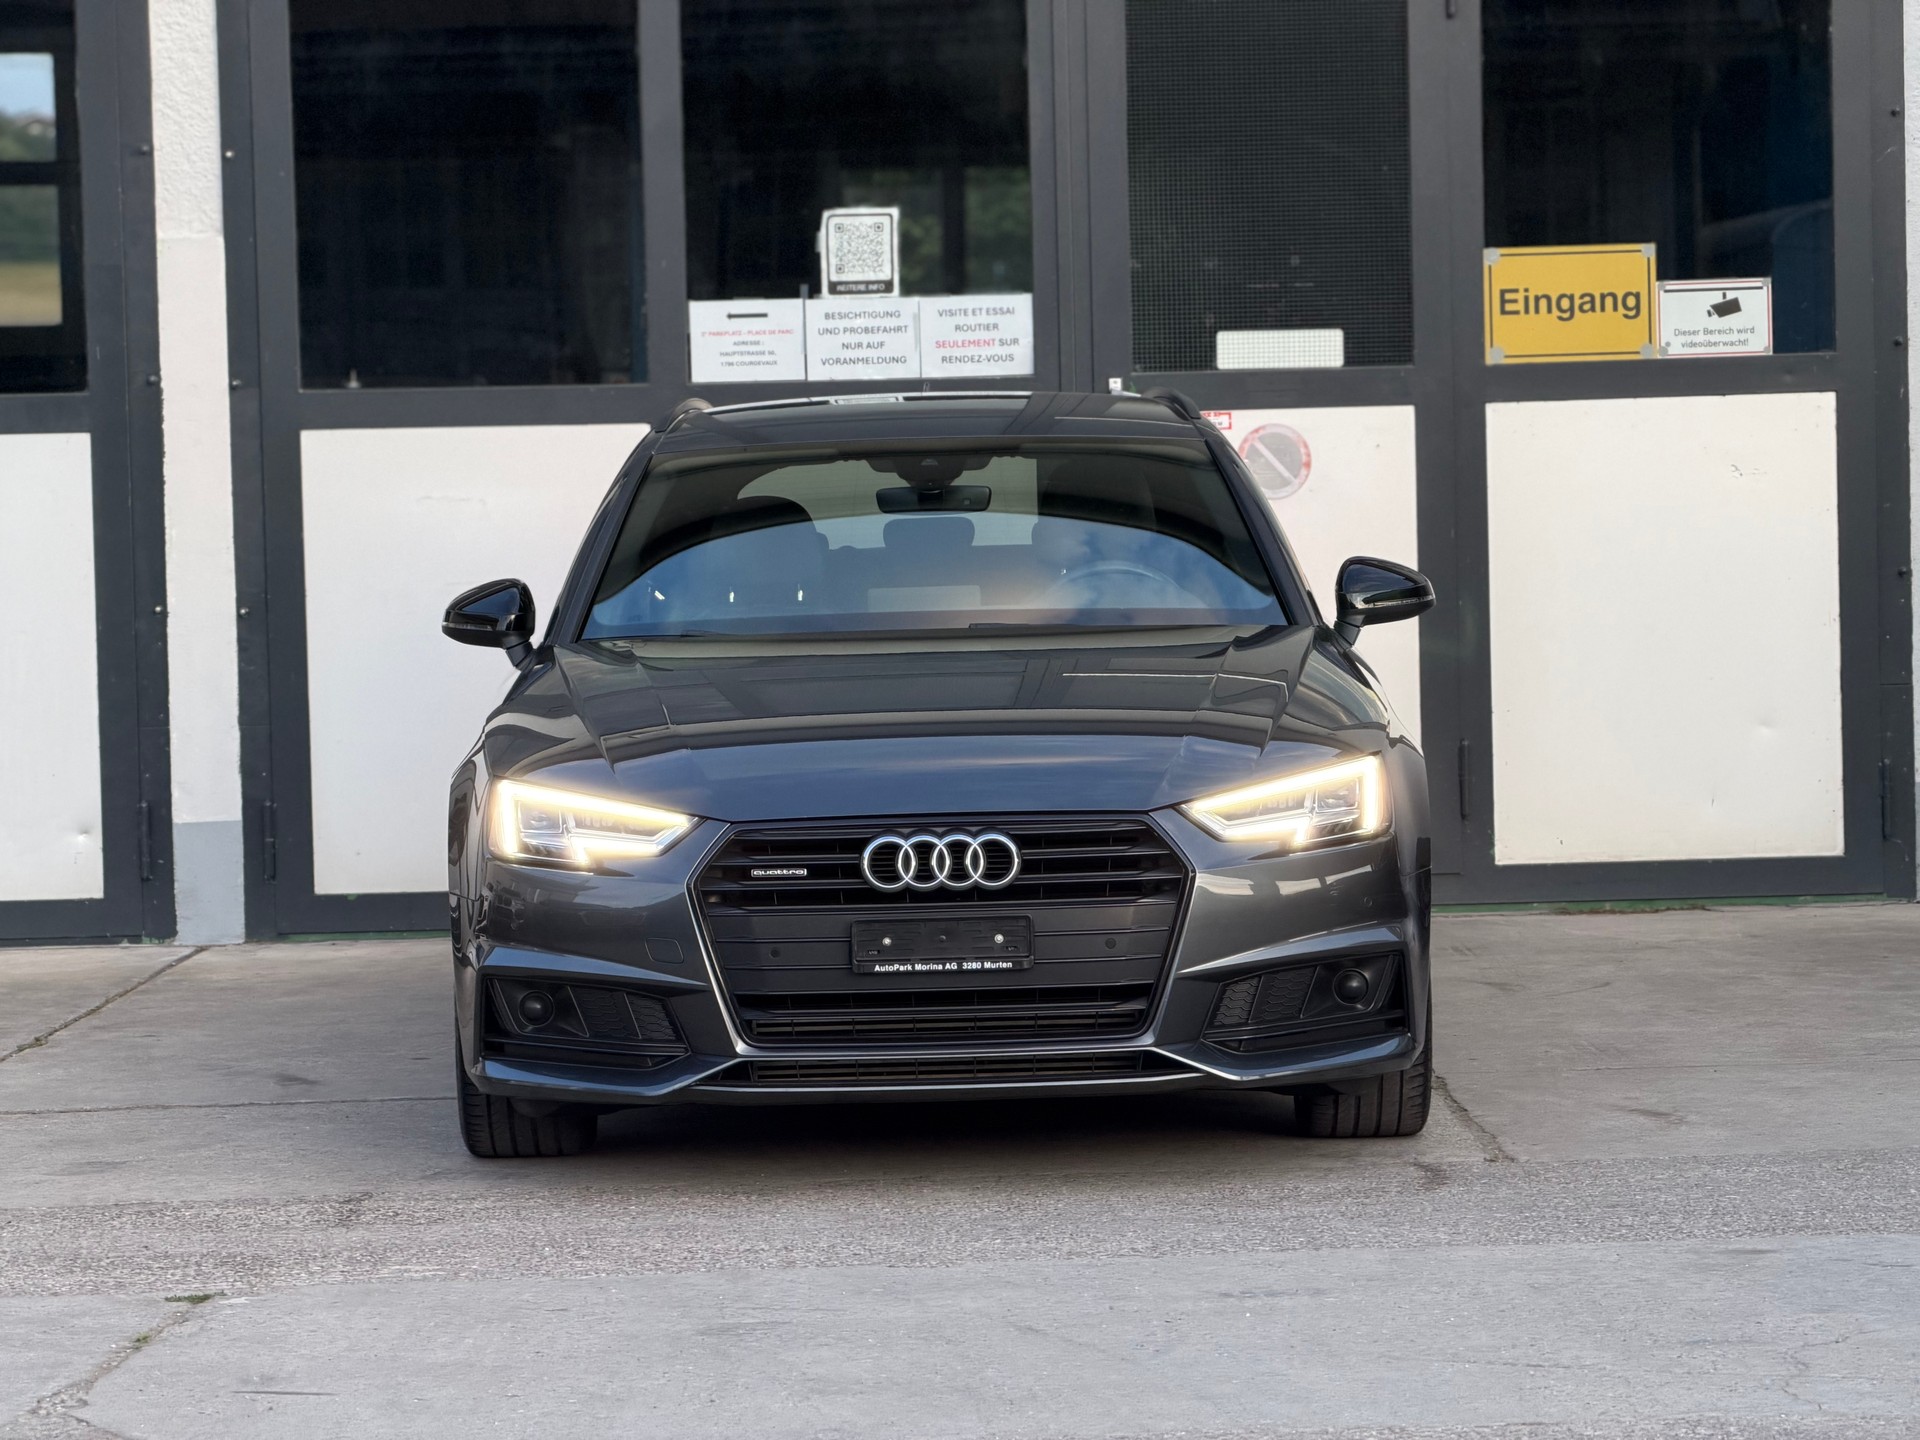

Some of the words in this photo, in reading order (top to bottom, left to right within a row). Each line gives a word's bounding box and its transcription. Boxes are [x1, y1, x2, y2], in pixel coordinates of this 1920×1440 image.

[1500, 287, 1641, 322] Eingang
[824, 310, 901, 320] BESICHTIGUNG
[937, 308, 969, 317] VISITE
[971, 307, 984, 316] ET
[985, 306, 1015, 316] ESSAI
[817, 327, 841, 336] UND
[842, 325, 908, 335] PROBEFAHRT
[954, 323, 1000, 332] ROUTIER
[1673, 328, 1701, 337] Dieser
[1703, 327, 1735, 336] Bereich
[1736, 326, 1755, 334] wird
[841, 341, 864, 350] NUR
[865, 341, 886, 349] AUF
[935, 338, 996, 349] SEULEMENT
[998, 338, 1020, 347] SUR
[1681, 338, 1749, 348] videoüberwacht!
[820, 355, 907, 366] VORANMELDUNG
[941, 353, 1015, 364] RENDEZ-VOUS
[874, 963, 913, 972] AutoPark
[915, 963, 943, 971] Morina
[944, 962, 958, 970] AG
[962, 962, 981, 970] 3280
[983, 961, 1013, 969] Murten
